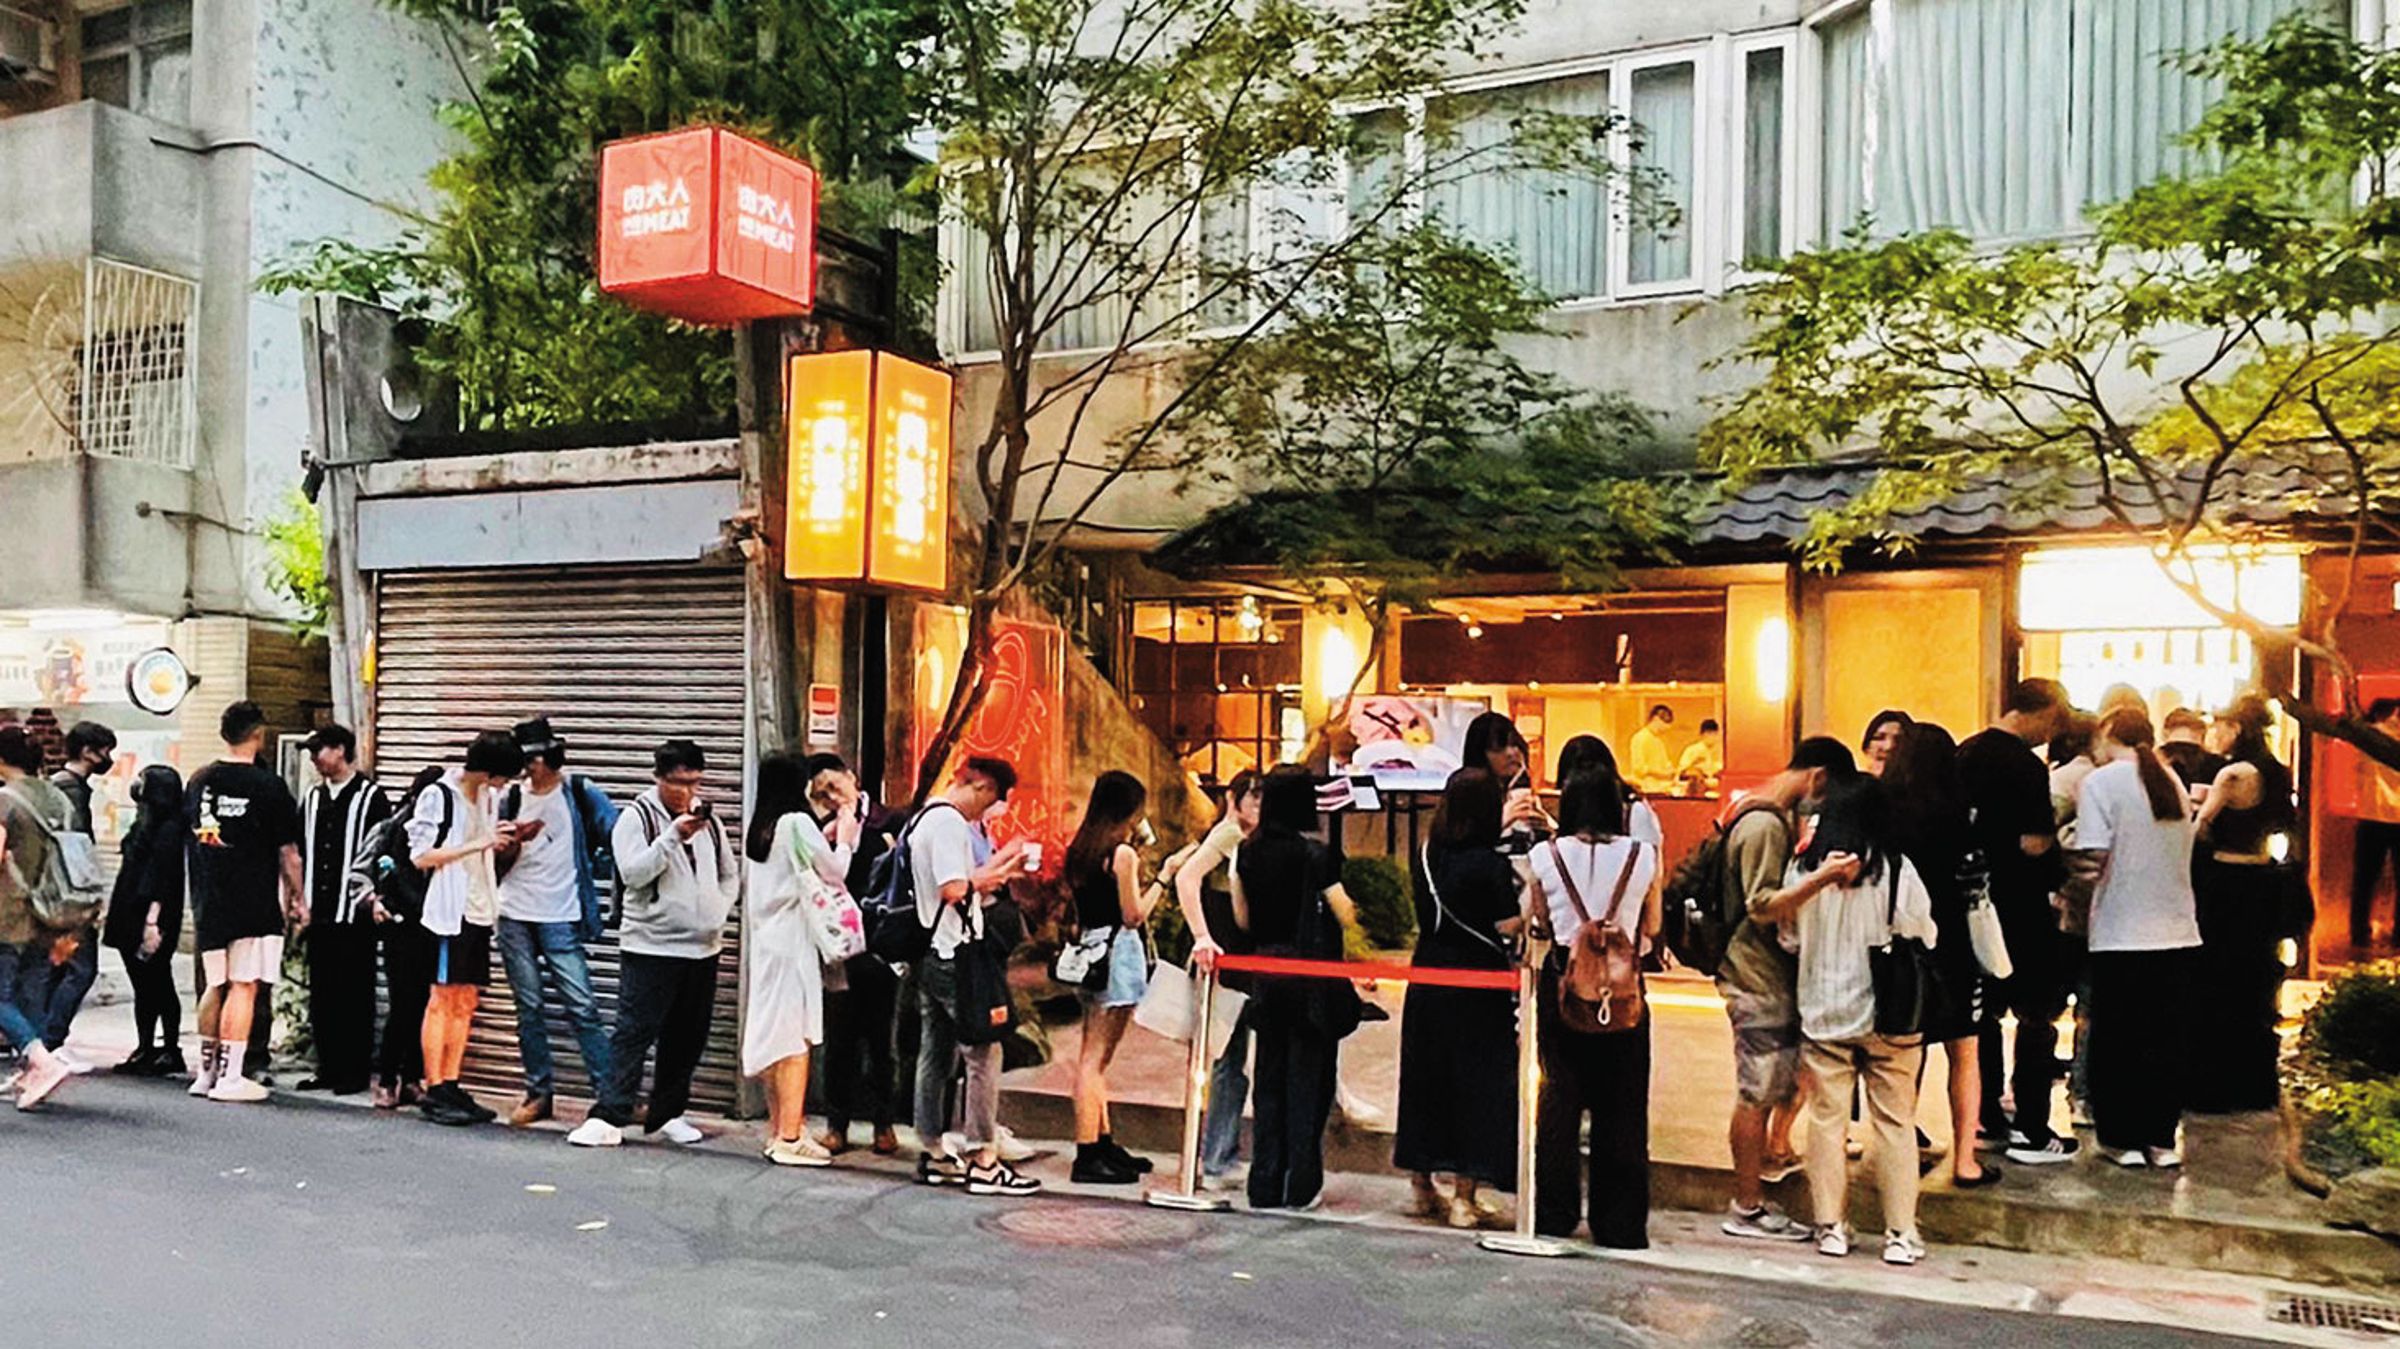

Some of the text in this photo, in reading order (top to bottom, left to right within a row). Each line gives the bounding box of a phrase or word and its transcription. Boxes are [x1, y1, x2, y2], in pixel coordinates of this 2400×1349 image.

[623, 177, 690, 213] 肉大人
[738, 186, 795, 229] 肉大人
